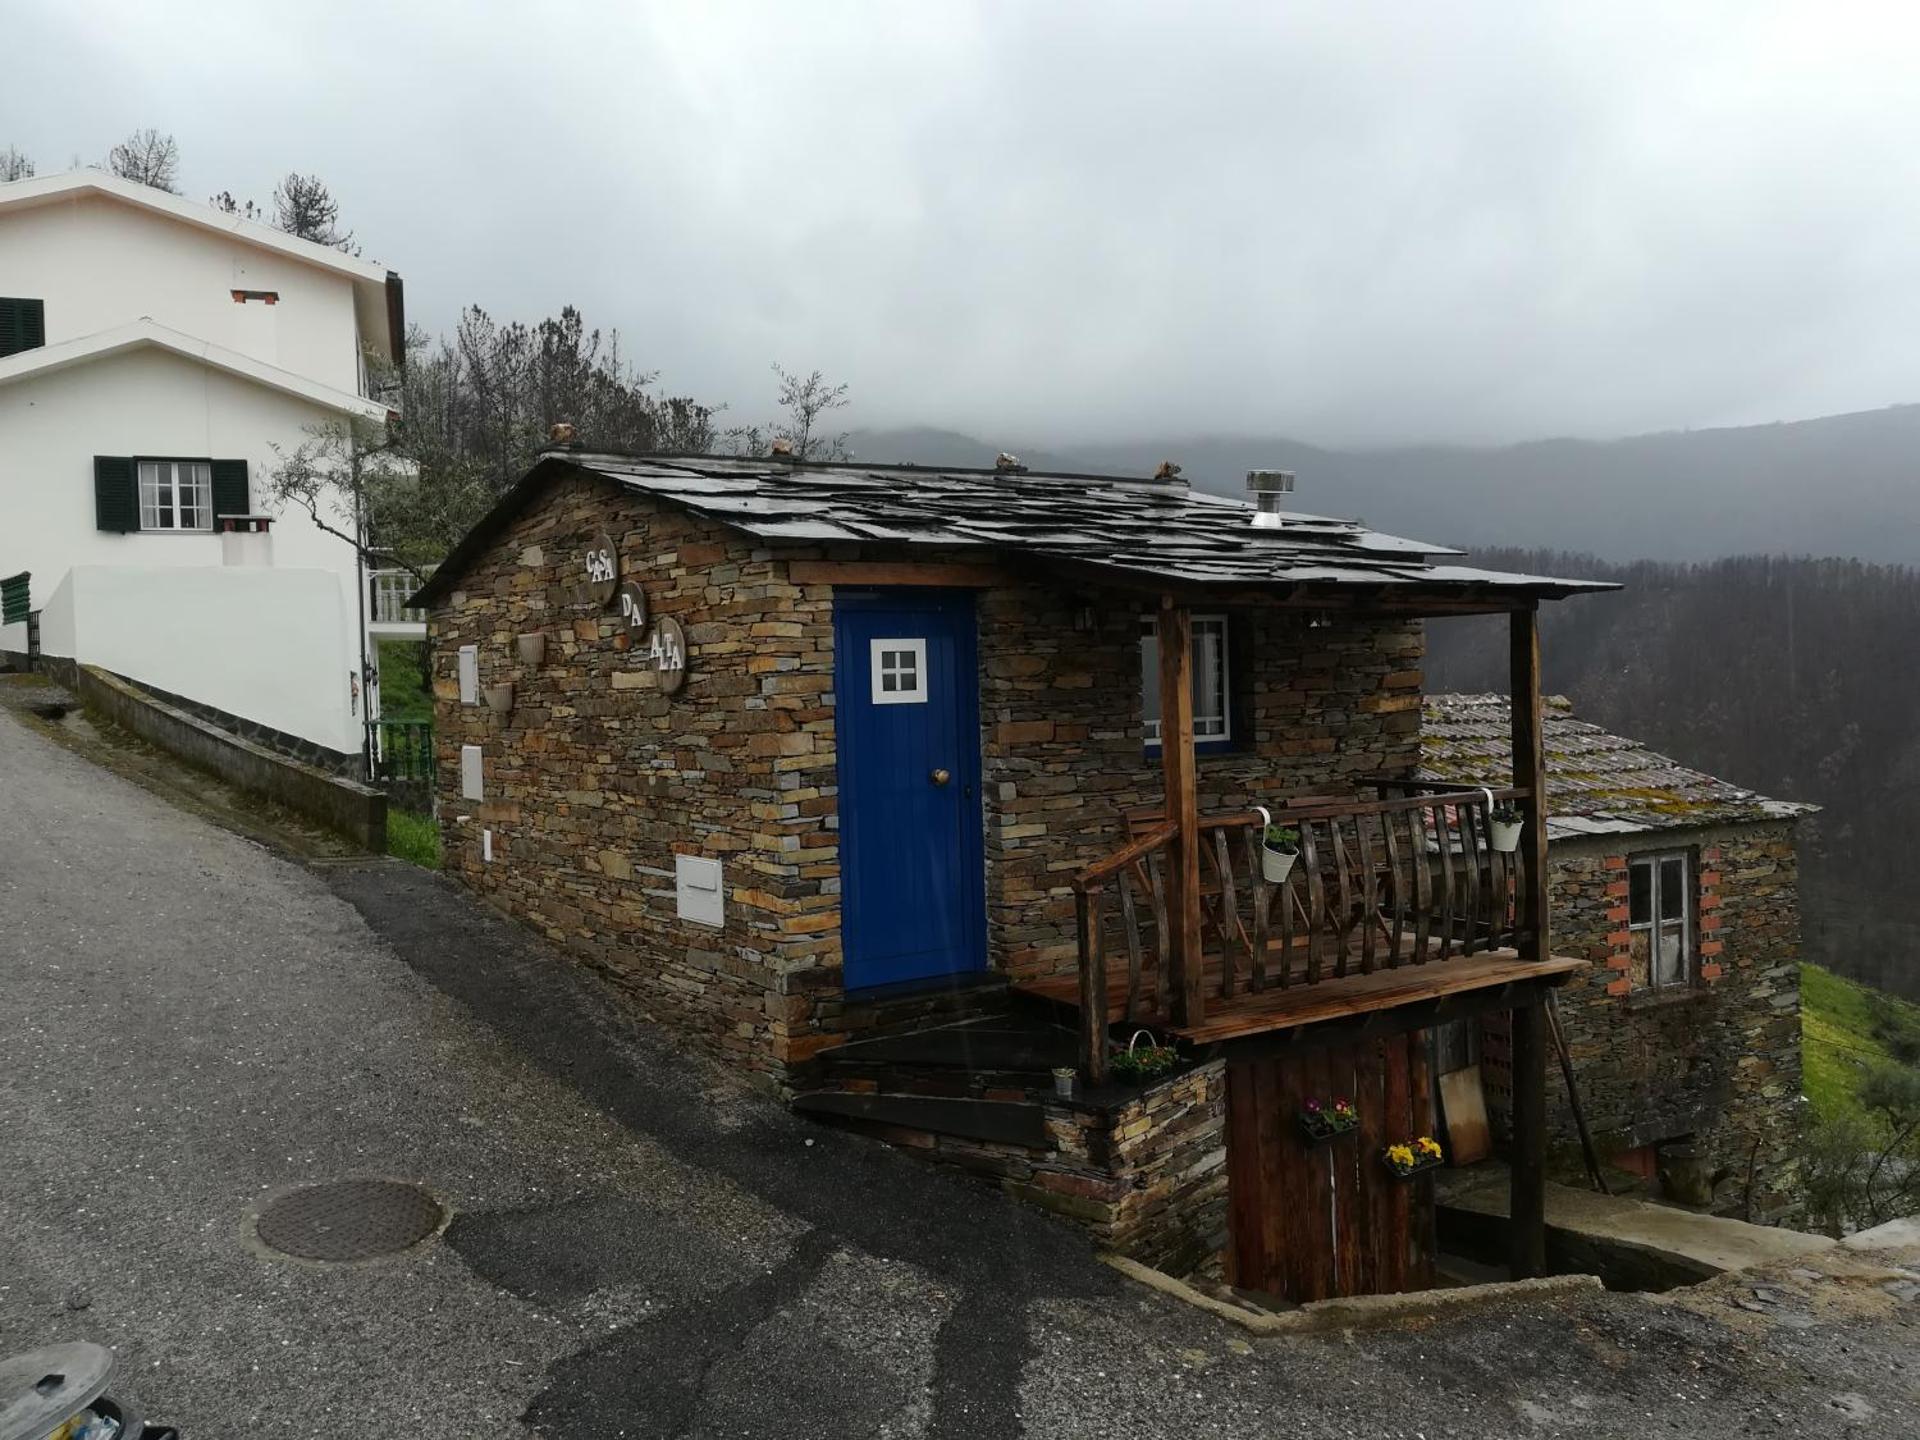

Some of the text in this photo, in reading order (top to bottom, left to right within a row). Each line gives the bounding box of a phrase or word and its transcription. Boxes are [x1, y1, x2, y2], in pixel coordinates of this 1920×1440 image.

[585, 550, 615, 583] CASA
[621, 593, 643, 627] DA
[650, 633, 683, 671] ALTA
